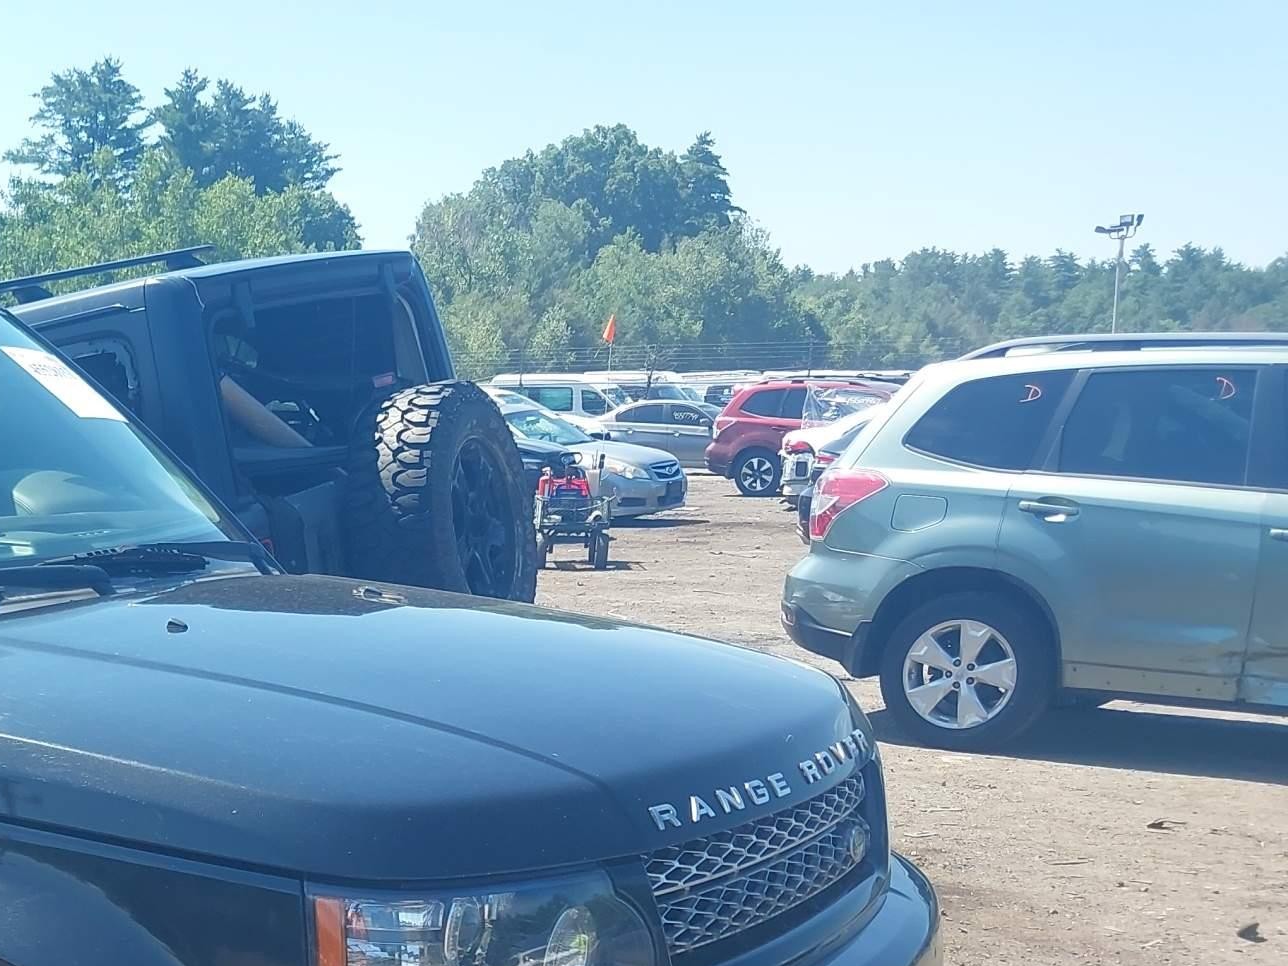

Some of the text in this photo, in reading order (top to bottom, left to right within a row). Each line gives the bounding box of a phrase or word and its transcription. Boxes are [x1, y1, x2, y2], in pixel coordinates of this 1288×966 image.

[1020, 384, 1042, 402] D
[647, 728, 869, 831] RANGE ROVER
